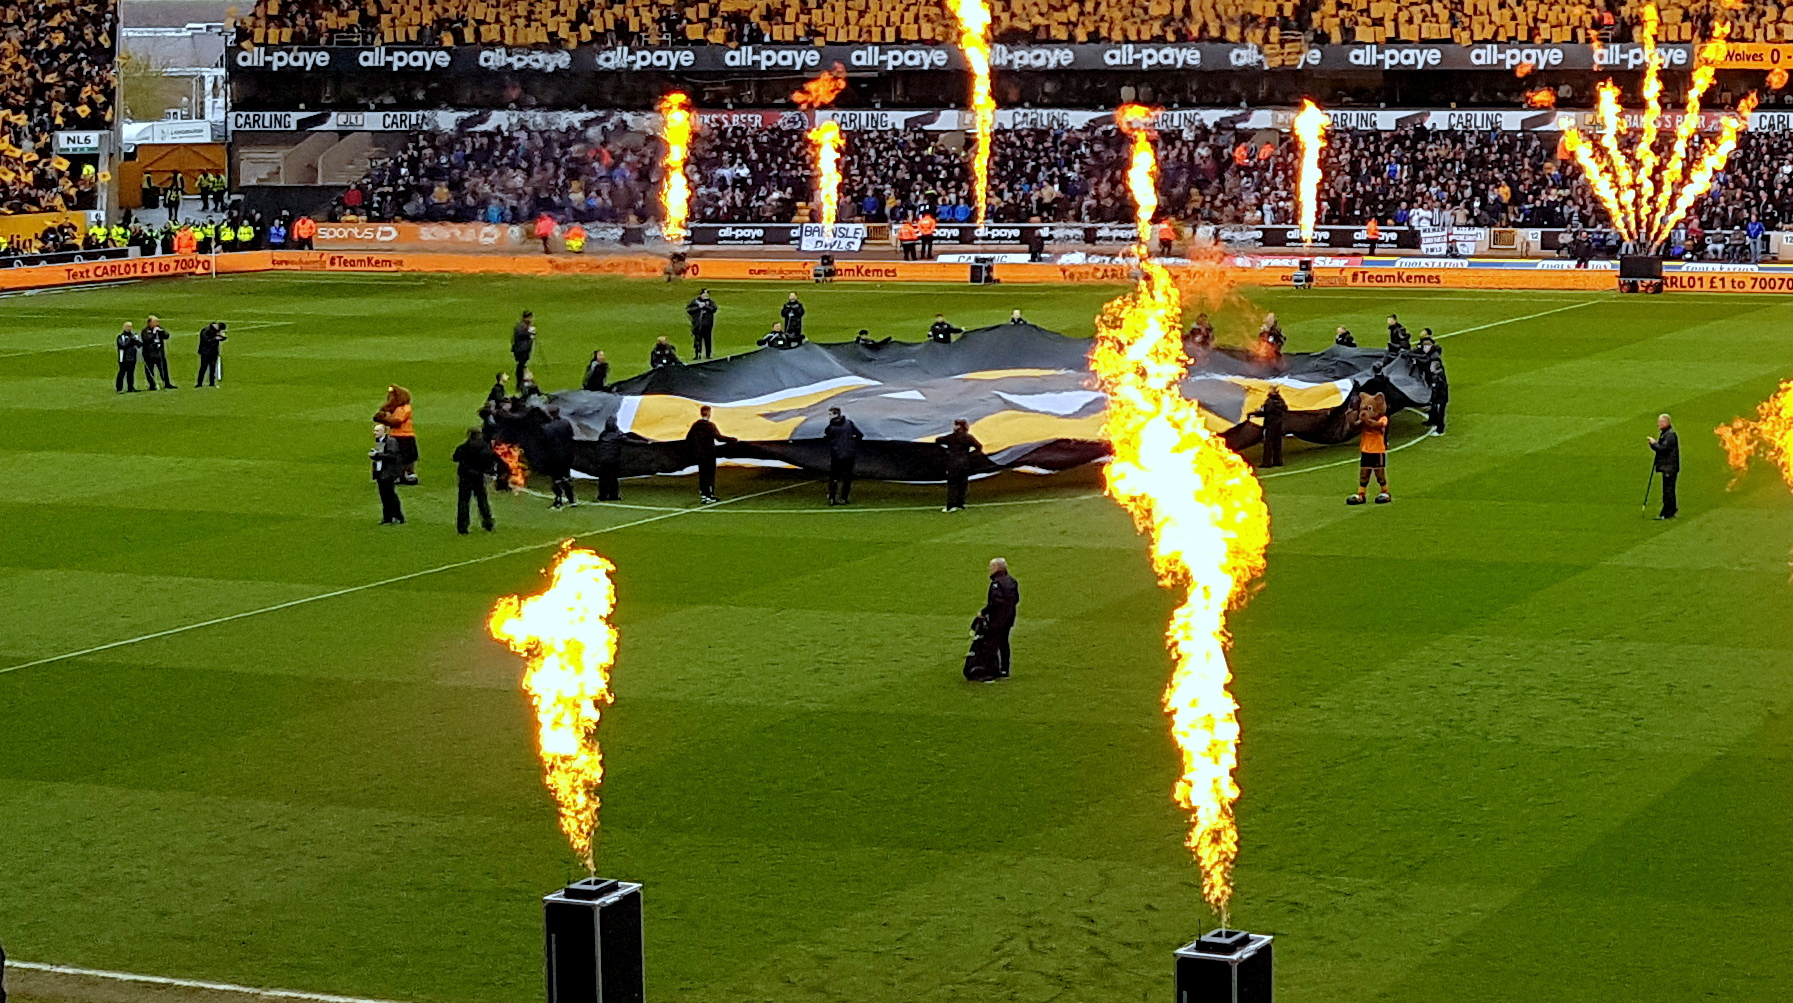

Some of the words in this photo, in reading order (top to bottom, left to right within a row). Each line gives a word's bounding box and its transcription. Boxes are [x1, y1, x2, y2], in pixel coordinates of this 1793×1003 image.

[236, 48, 330, 71] all-paye
[358, 47, 451, 71] all-paye
[596, 47, 695, 71] all-paye
[724, 46, 821, 70] all-paye
[851, 46, 948, 69] all-paye
[990, 44, 1075, 69] ll-paye
[1103, 45, 1201, 69] all-paye
[1350, 45, 1441, 69] all-paye
[1470, 45, 1563, 69] all-paye
[1593, 44, 1687, 69] all-pye
[1724, 50, 1764, 62] Wolves
[1770, 49, 1780, 65] 0
[234, 113, 292, 129] CARLING
[831, 112, 889, 128] CARLING
[1012, 111, 1070, 127] CARLING
[1153, 112, 1201, 129] ARLING
[1331, 113, 1377, 128] ARLING
[1449, 113, 1502, 129] CARLING
[66, 135, 92, 145] NL6
[317, 225, 374, 241] sports
[718, 227, 764, 239] all-paye
[1530, 232, 1539, 240] 12
[1785, 235, 1793, 244] 12
[65, 267, 90, 281] Text
[93, 262, 138, 278] CARL01
[141, 262, 155, 274] £1
[159, 261, 170, 273] to
[836, 264, 897, 278] amKemes
[1351, 270, 1441, 285] #TeamKemes
[1663, 276, 1704, 289] ARL01
[1709, 276, 1724, 289] £1
[1731, 277, 1745, 290] to
